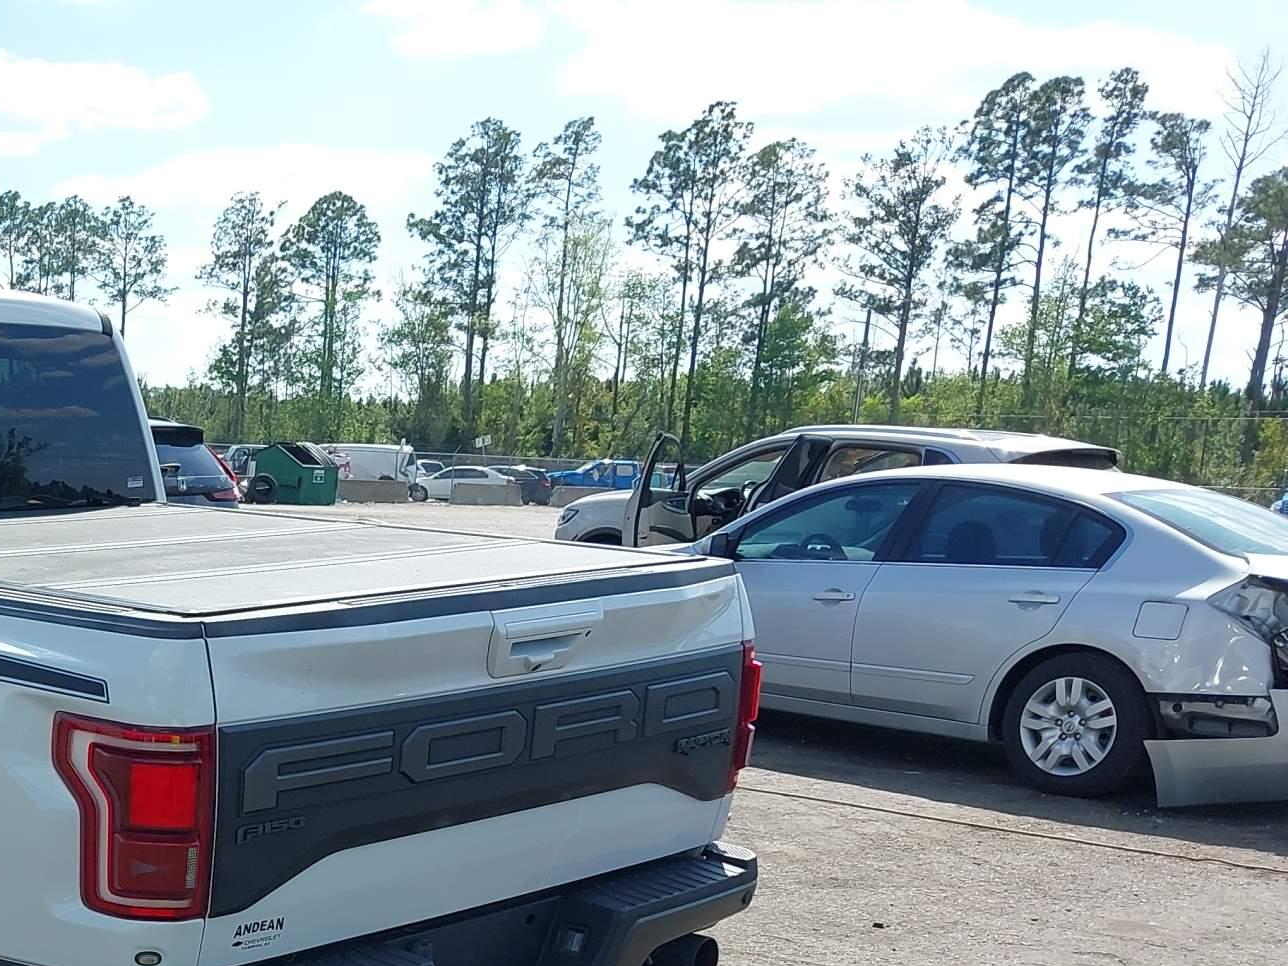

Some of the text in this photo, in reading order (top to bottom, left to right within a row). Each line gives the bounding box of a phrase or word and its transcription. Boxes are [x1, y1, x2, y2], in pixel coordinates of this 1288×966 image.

[240, 671, 736, 817] FORD
[233, 916, 285, 939] ANDEAN
[244, 934, 281, 946] CHEVROLET
